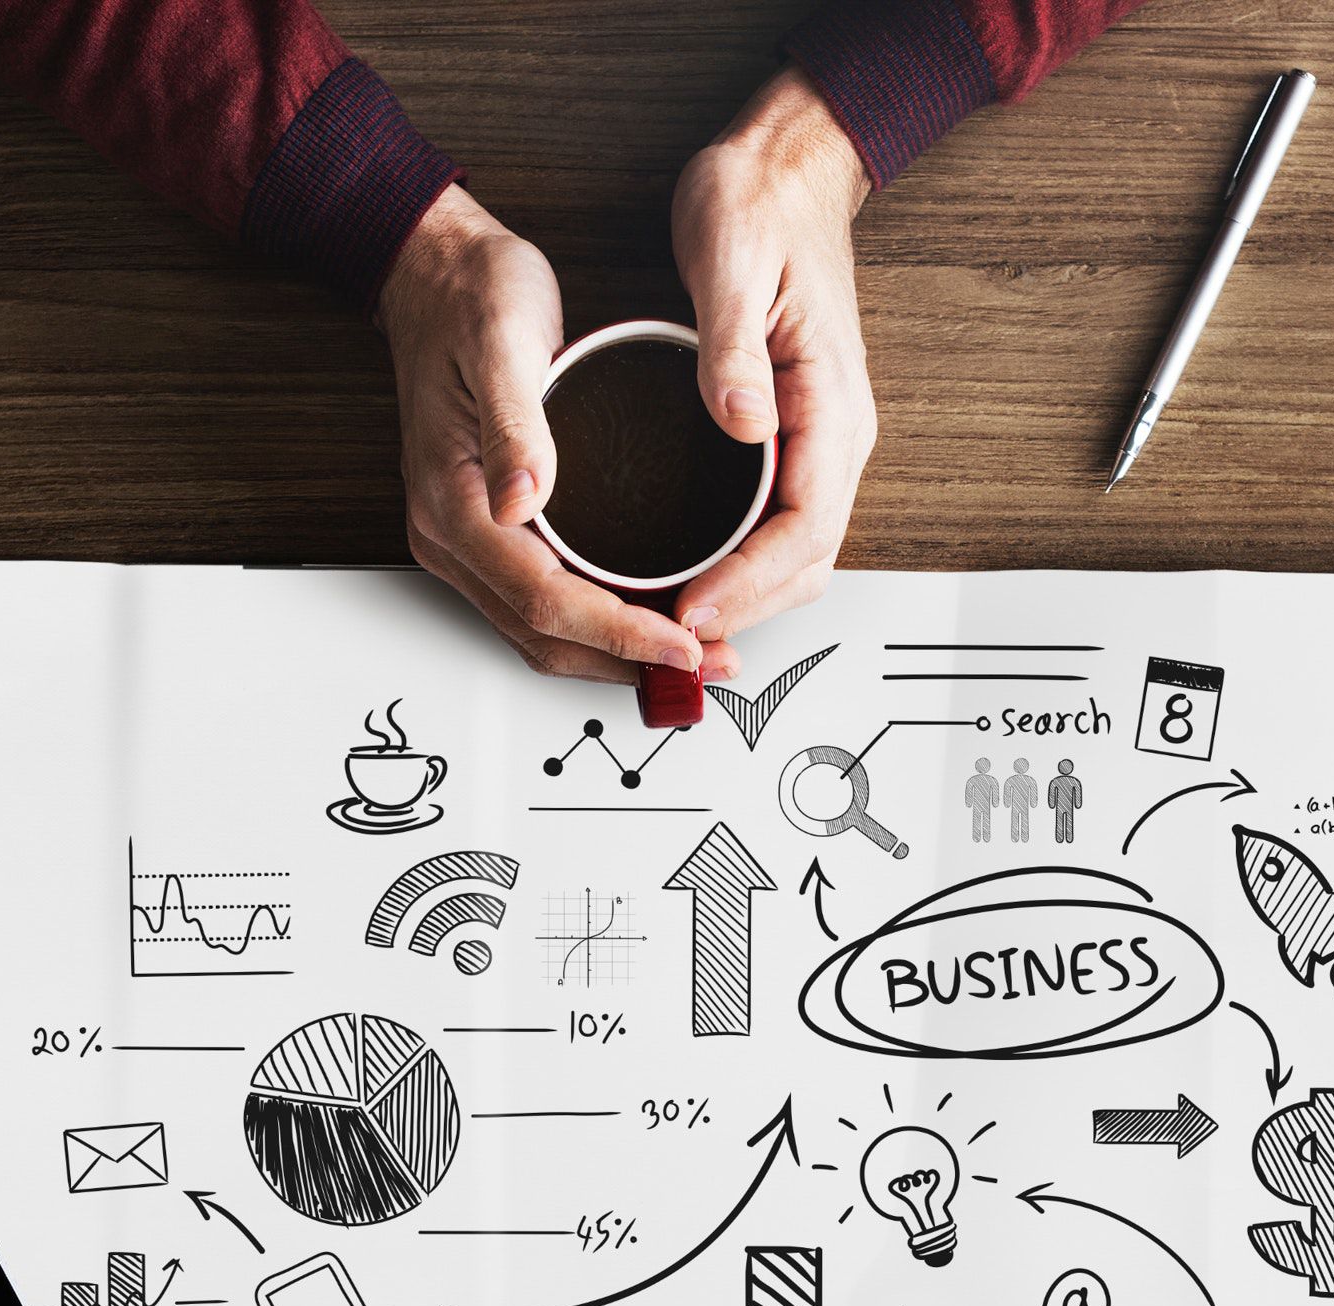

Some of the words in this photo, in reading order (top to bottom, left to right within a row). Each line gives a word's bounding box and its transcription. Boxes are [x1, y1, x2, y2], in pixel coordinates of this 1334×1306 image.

[1002, 697, 1110, 736] search
[1160, 694, 1193, 744] 8
[879, 934, 1162, 1014] BUSINESS
[32, 1027, 102, 1057] 20%
[571, 1011, 626, 1044] 10%
[642, 1098, 710, 1129] 30%
[577, 1211, 637, 1253] 45%
